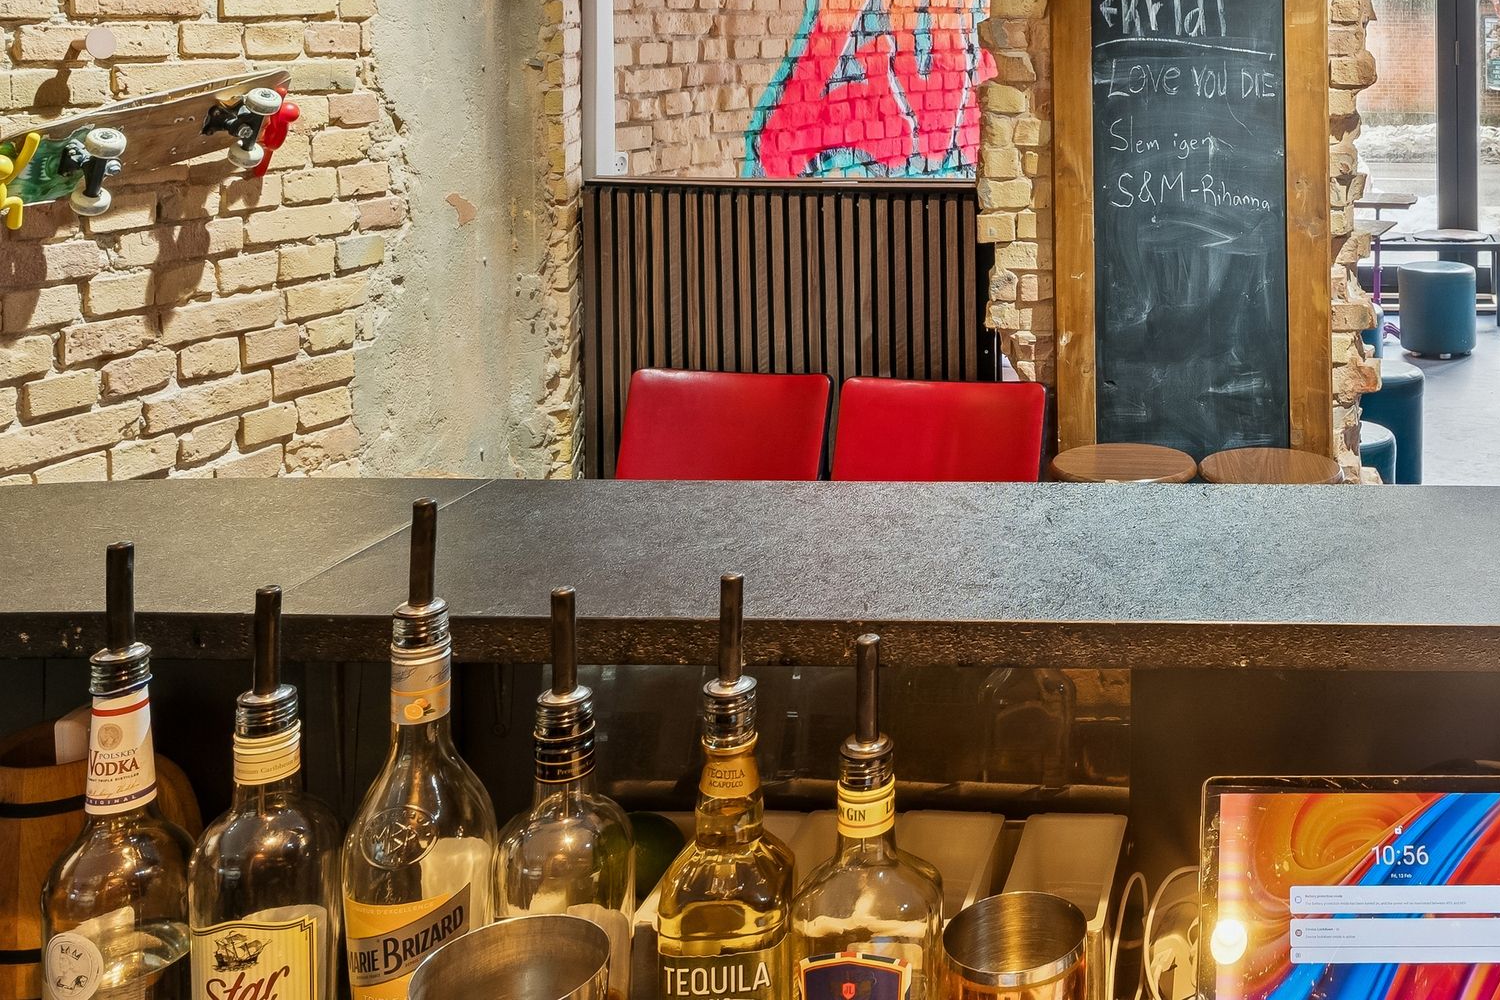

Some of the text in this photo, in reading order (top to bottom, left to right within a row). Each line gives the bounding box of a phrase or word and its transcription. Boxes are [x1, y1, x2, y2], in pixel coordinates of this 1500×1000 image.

[89, 749, 140, 776] VODKA
[706, 767, 746, 780] TEQUILA
[1371, 845, 1429, 866] 10:56
[383, 905, 465, 975] BRIZARD
[663, 961, 772, 996] TEQUILA
